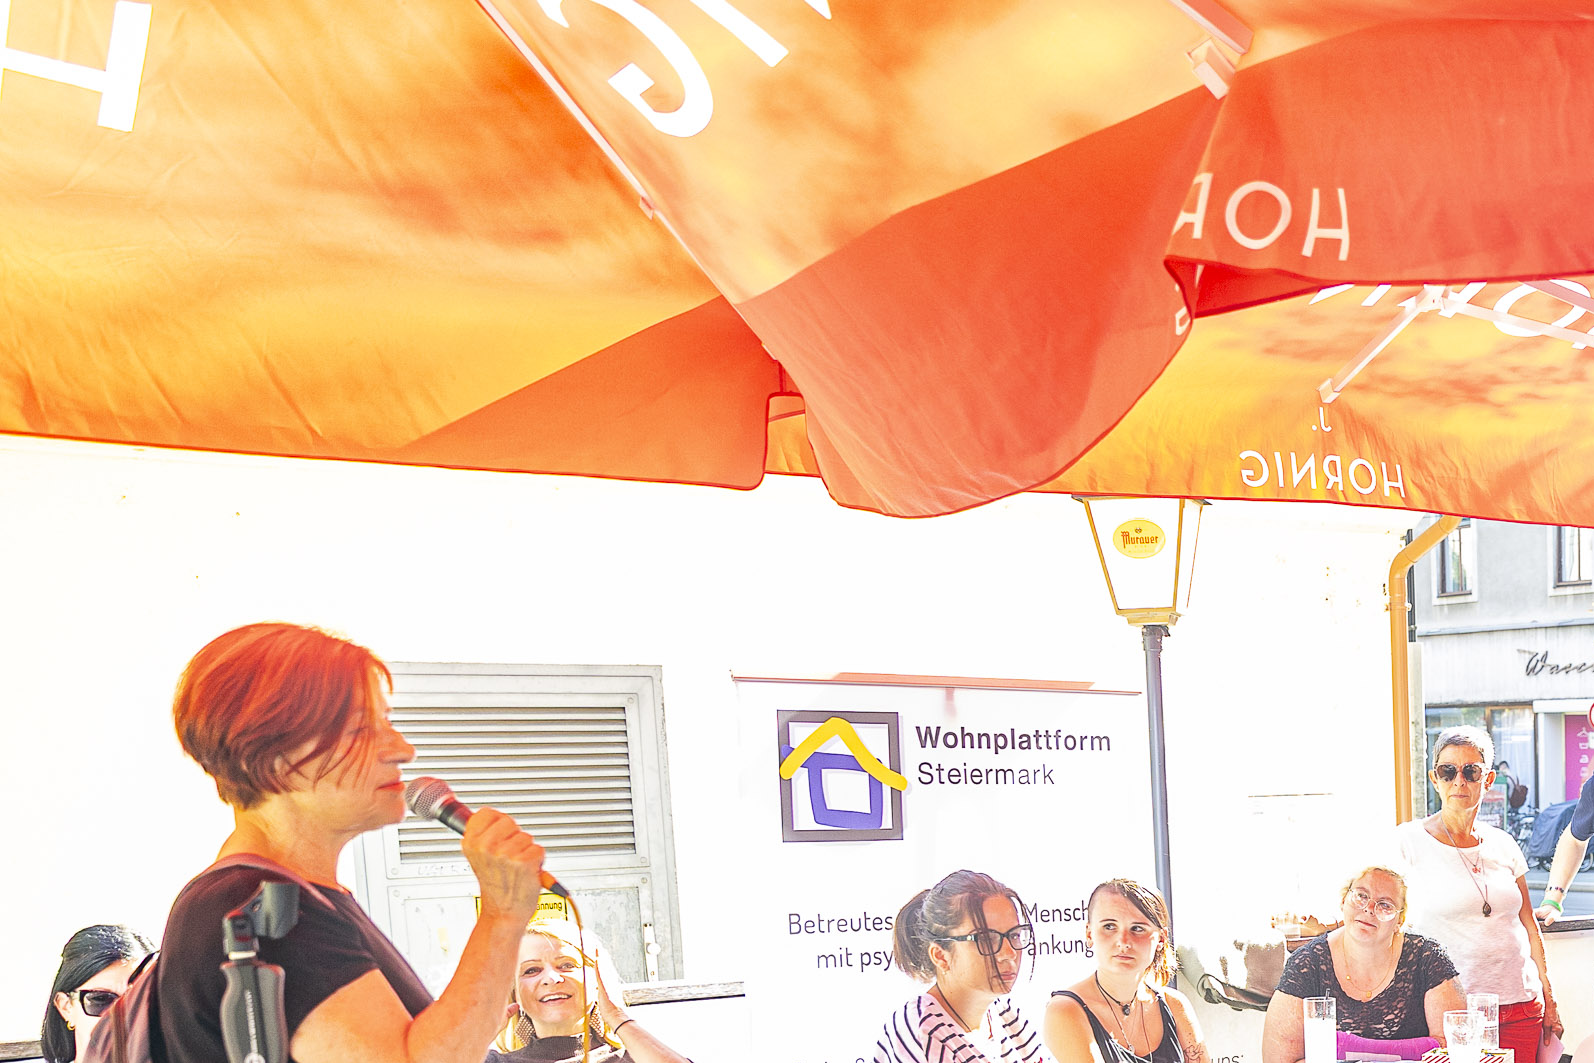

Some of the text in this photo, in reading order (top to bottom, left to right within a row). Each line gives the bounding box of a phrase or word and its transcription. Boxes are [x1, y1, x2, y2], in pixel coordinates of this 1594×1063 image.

[1121, 530, 1159, 549] Murauer
[915, 726, 1111, 755] Wohnplattform
[918, 762, 1055, 785] Steiermark
[788, 911, 893, 935] Betreutes
[817, 947, 853, 968] mit
